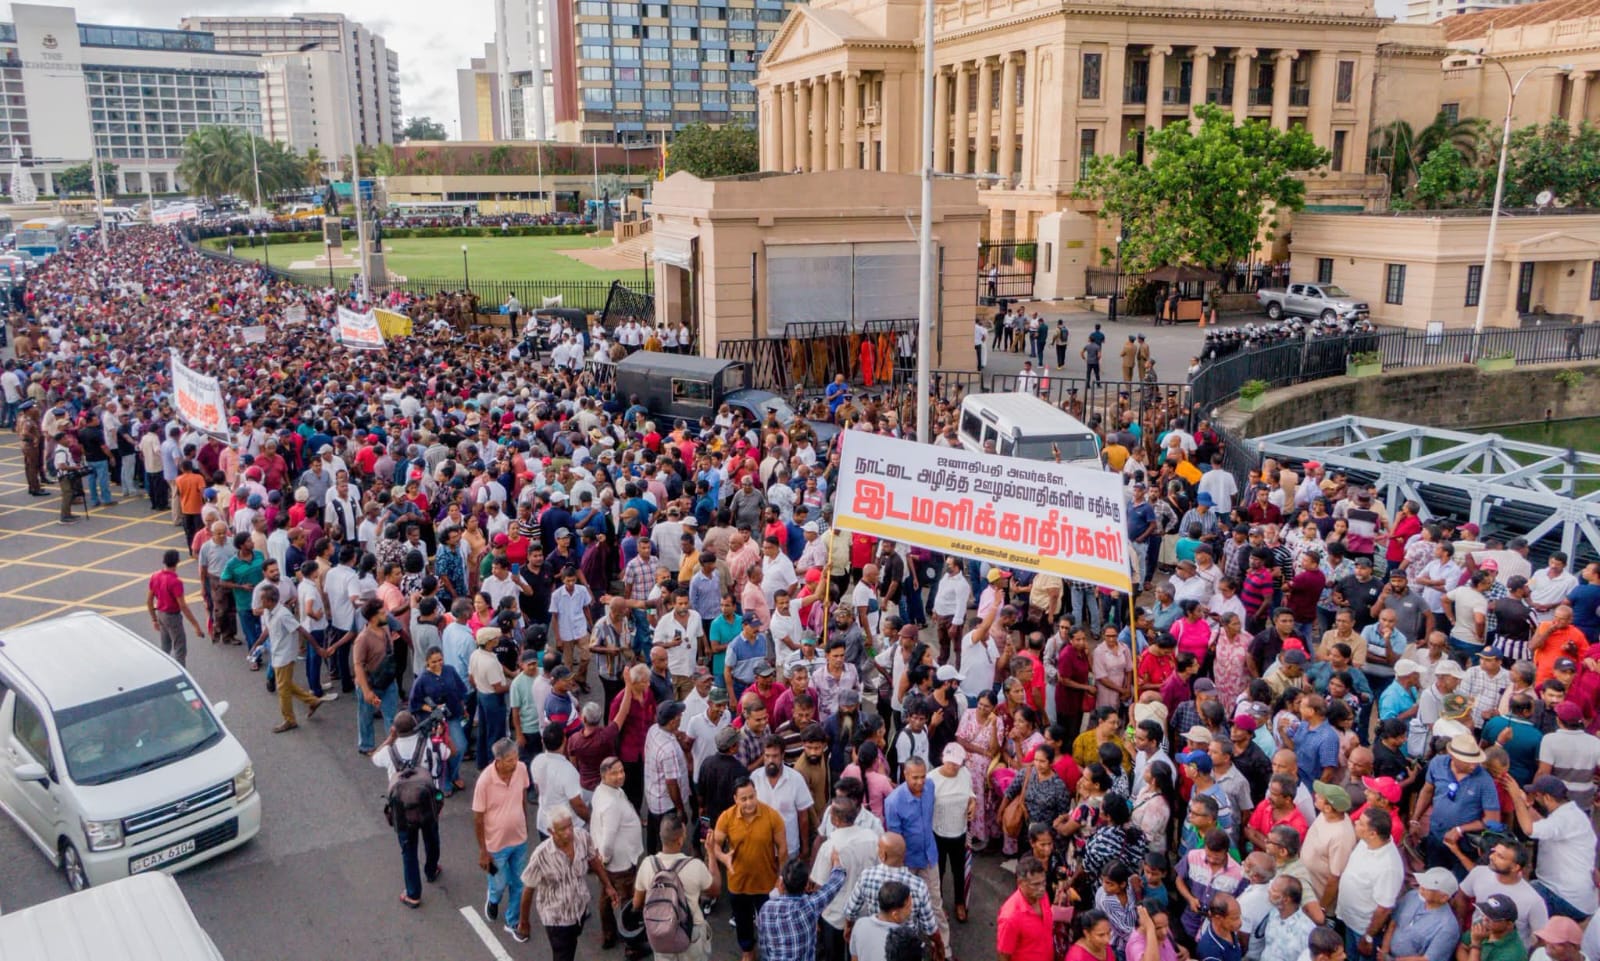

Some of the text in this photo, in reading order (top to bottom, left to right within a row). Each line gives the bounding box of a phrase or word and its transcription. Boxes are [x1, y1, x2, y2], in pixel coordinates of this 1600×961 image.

[855, 455, 912, 481] நாட்டை
[917, 468, 970, 494] அழித்த
[973, 480, 1085, 509] ஊழல்வாதிகளின்
[852, 478, 1124, 565] இடமளிக்காதீர்கள்!
[143, 841, 194, 867] CAX 6104
